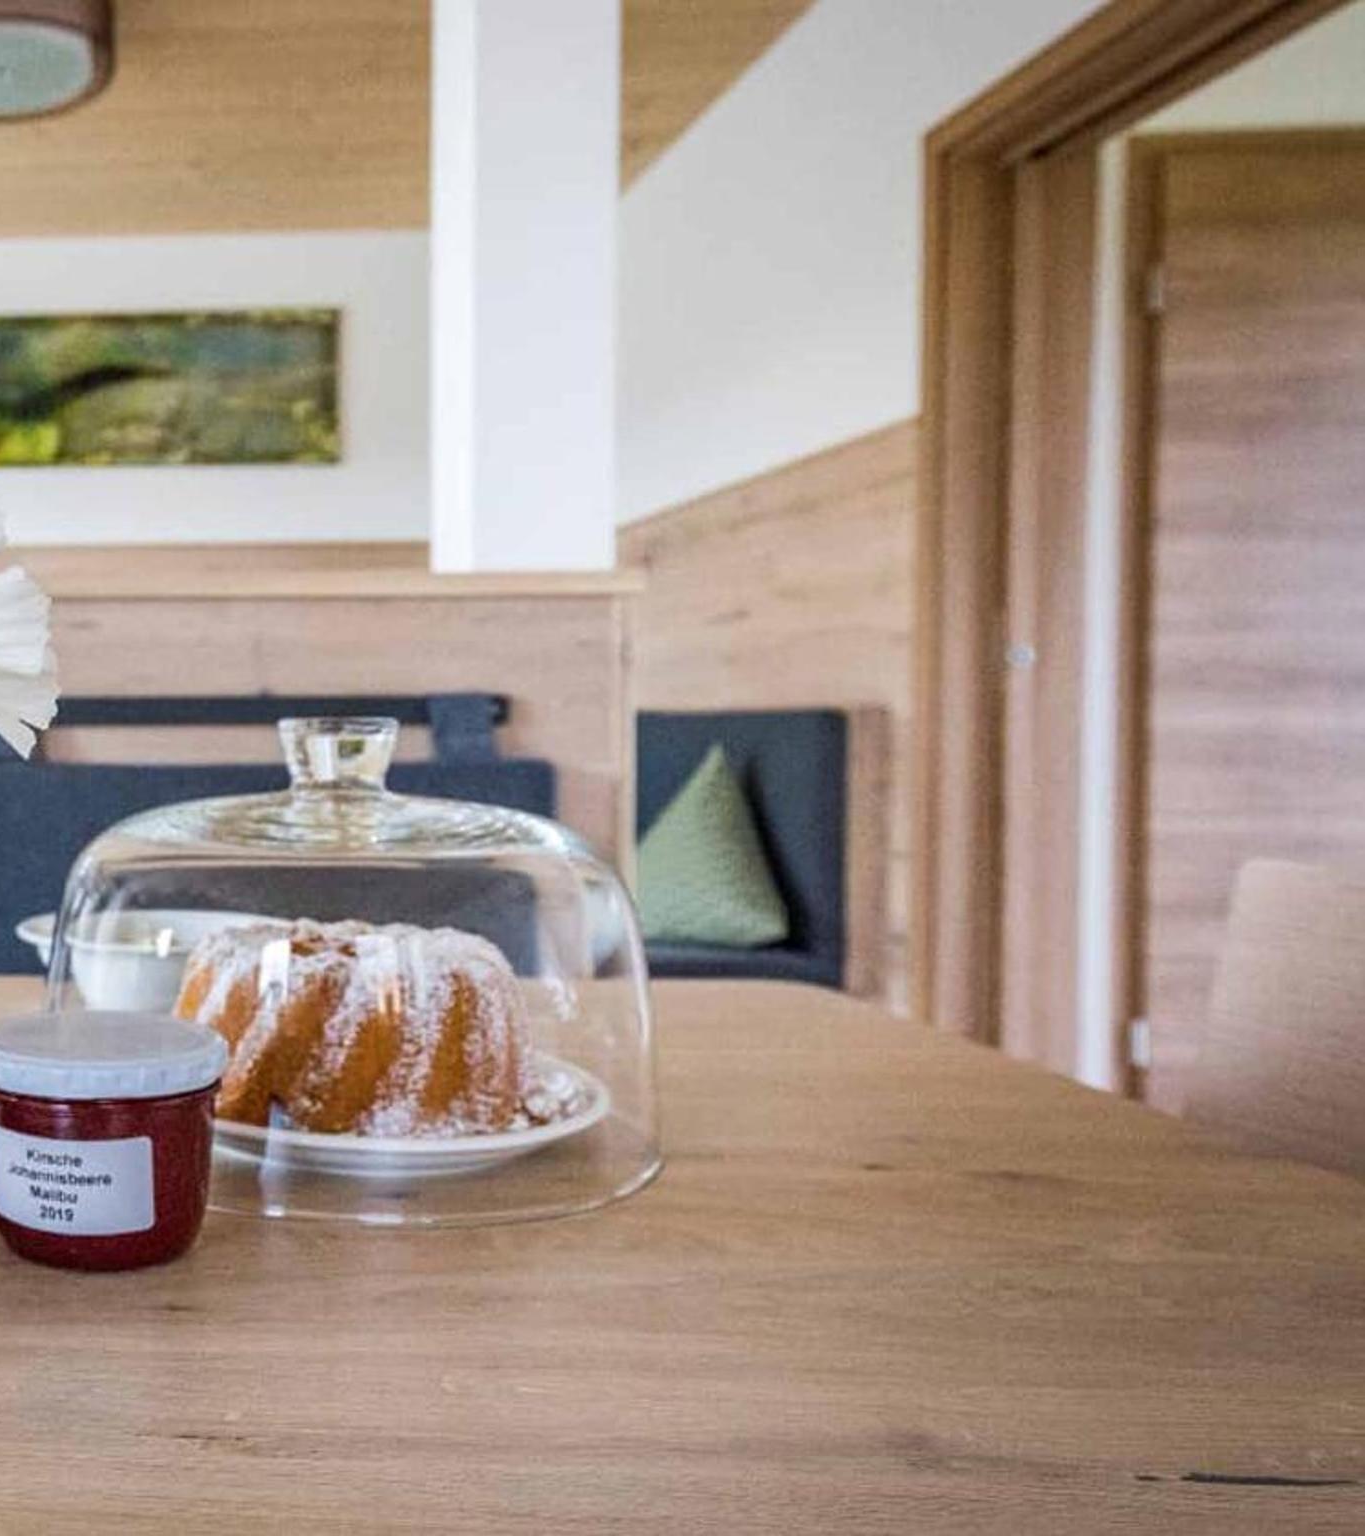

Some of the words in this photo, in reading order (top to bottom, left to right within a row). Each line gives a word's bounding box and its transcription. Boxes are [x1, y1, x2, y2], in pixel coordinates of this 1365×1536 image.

[26, 1150, 83, 1168] Kirsche
[8, 1165, 112, 1186] Johannisbeere
[30, 1185, 78, 1204] Malibu
[39, 1204, 74, 1222] 2019
